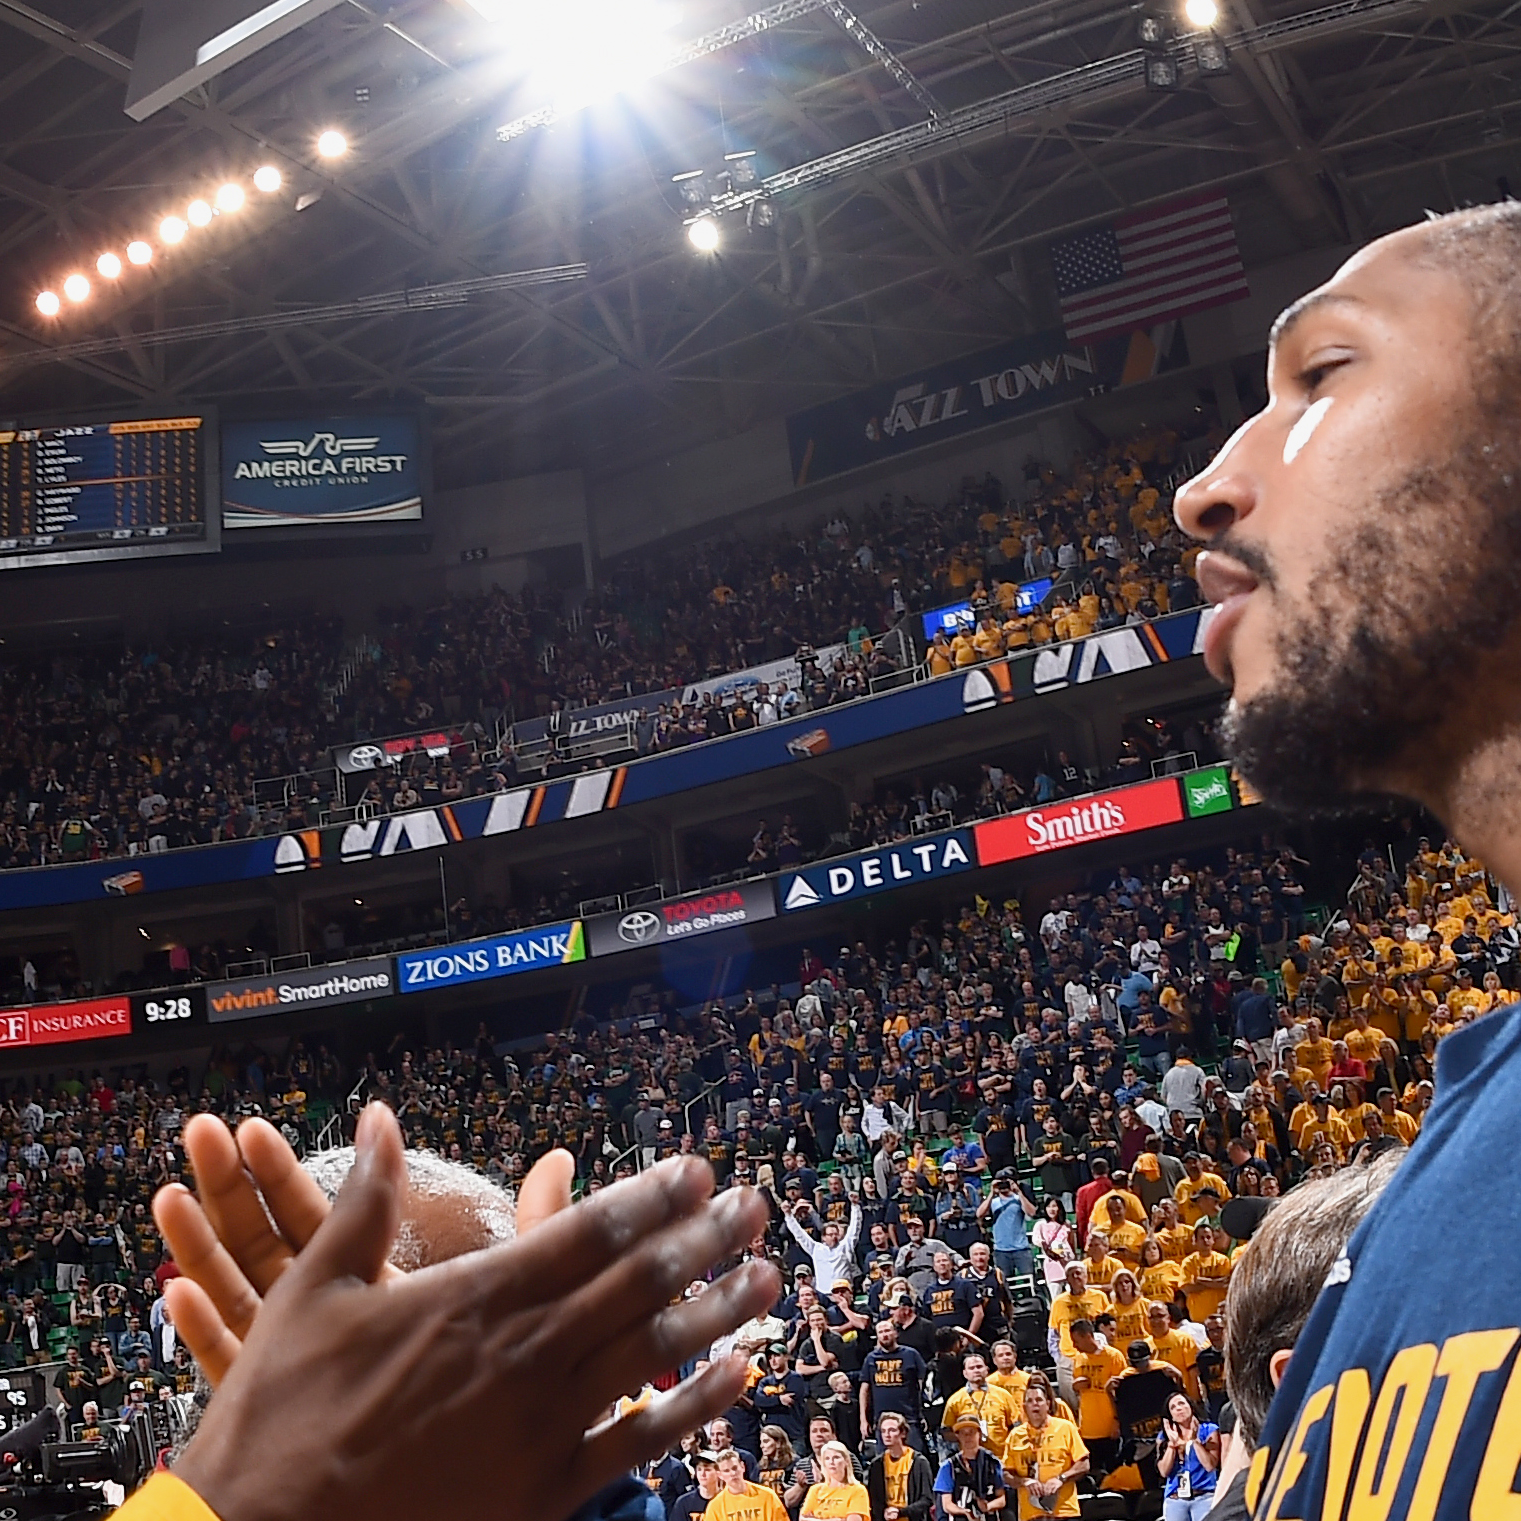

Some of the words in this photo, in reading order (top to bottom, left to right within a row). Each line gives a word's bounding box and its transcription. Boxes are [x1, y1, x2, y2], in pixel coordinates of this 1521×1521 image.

[972, 346, 1093, 407] TOWN
[234, 459, 338, 479] AMERICA
[340, 455, 408, 474] FIRST
[273, 477, 322, 488] CREDIT
[328, 476, 369, 486] UNION
[1062, 766, 1078, 781] 12
[1025, 800, 1126, 845] Smith's
[829, 838, 970, 896] DELTA
[662, 890, 744, 921] TOYOTA
[666, 919, 691, 936] Let's
[693, 917, 709, 931] Go
[709, 909, 747, 927] Places
[406, 951, 488, 984] ZIONS
[497, 934, 574, 967] BANK
[33, 1010, 126, 1034] INSURANCE
[145, 998, 192, 1022] 9:28
[874, 1371, 903, 1385] NOTE
[7, 1391, 27, 1406] 95
